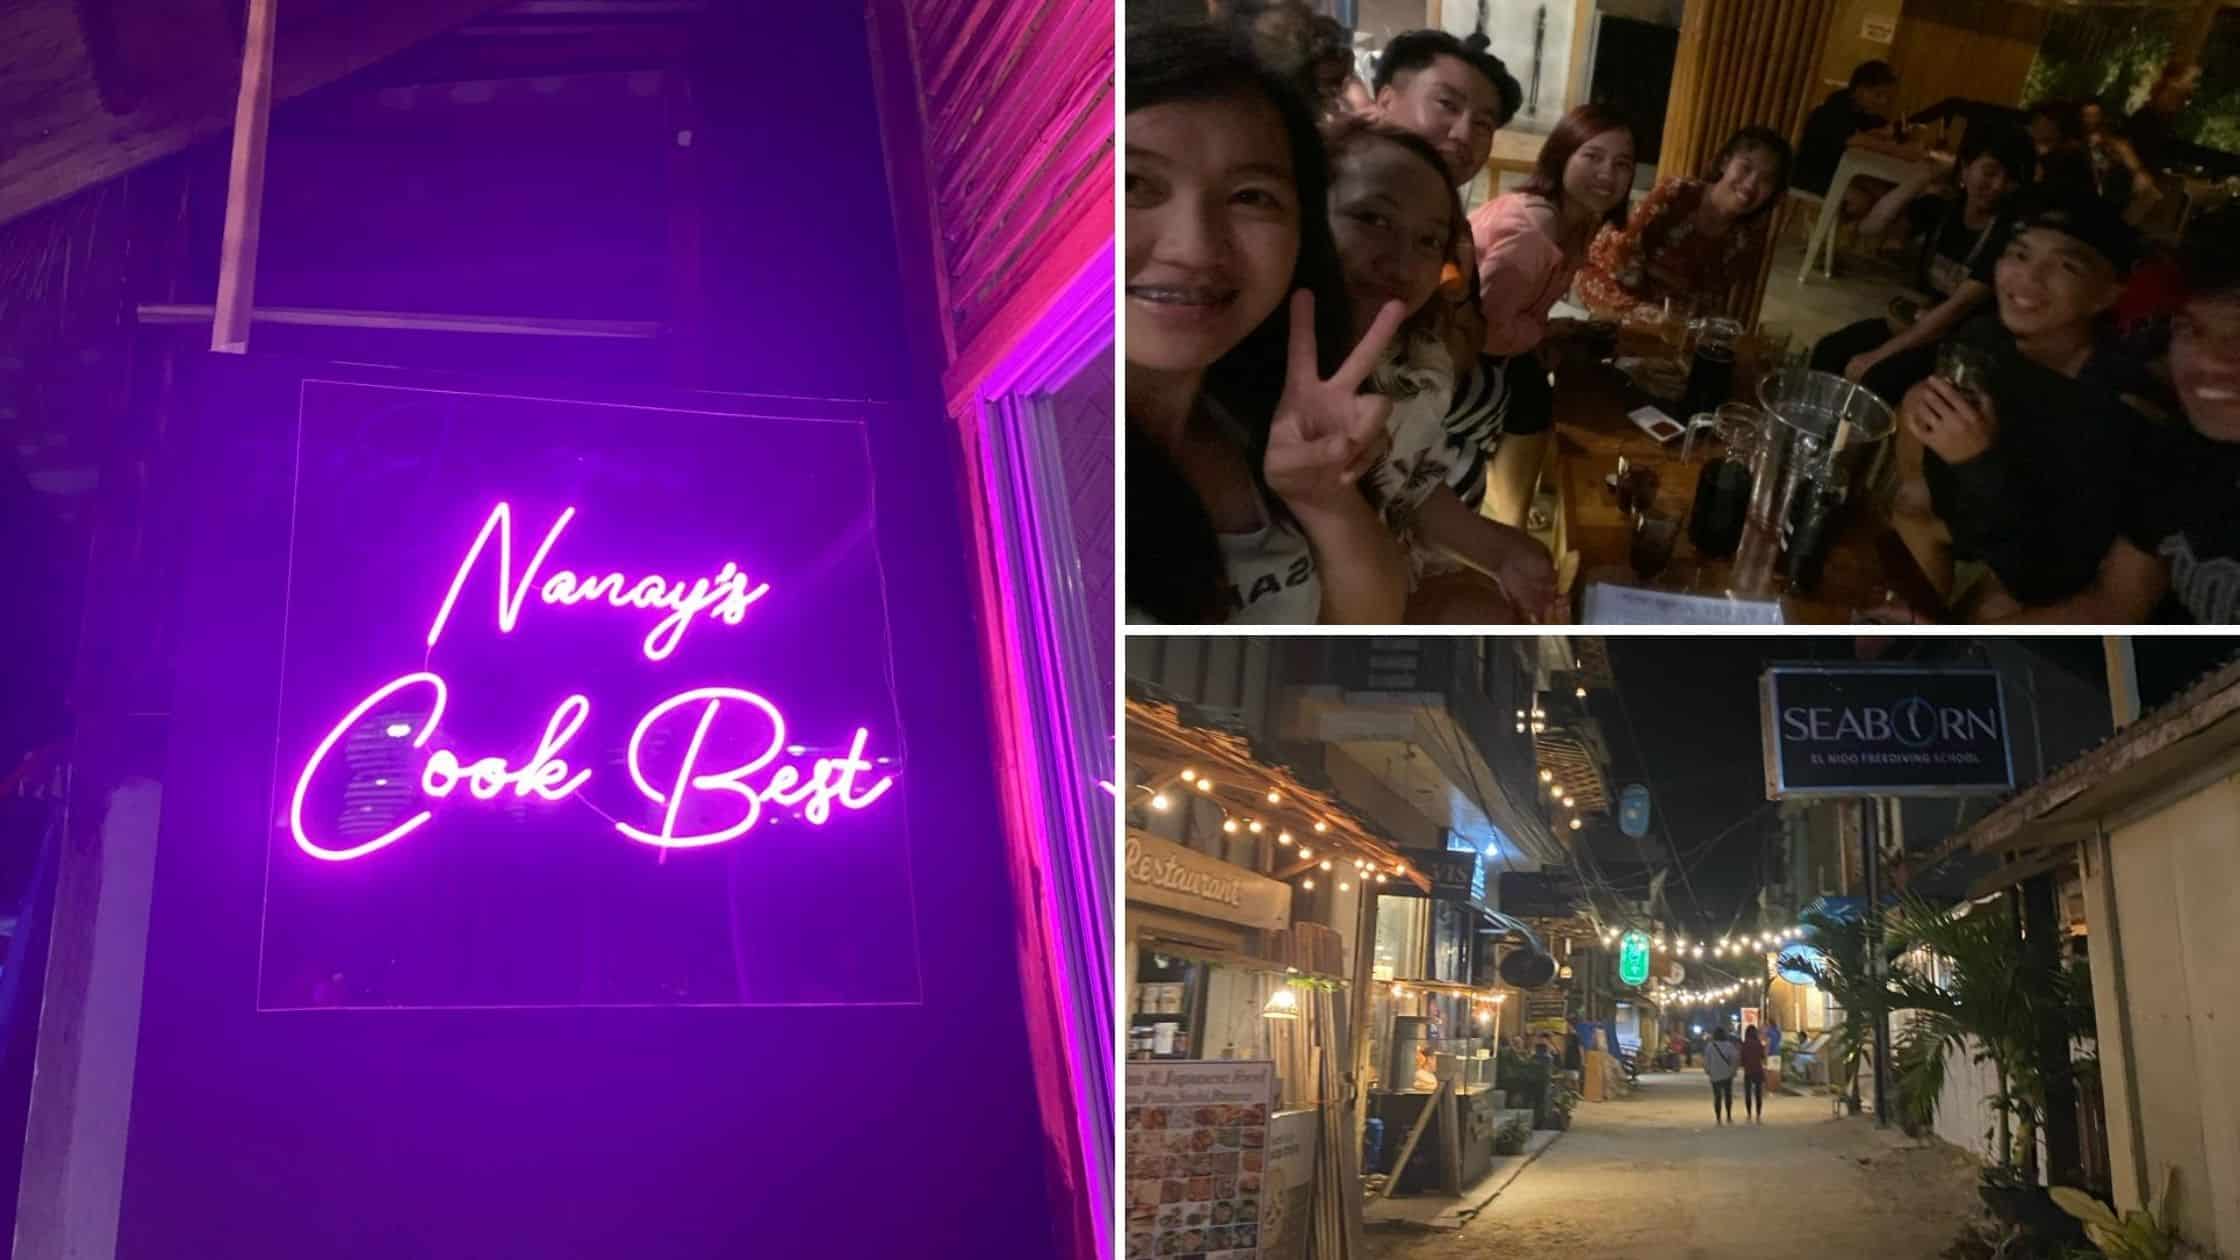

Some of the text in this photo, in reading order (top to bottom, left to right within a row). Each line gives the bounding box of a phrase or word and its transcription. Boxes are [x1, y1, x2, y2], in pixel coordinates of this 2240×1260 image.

[425, 500, 770, 662] Nanay's
[289, 671, 893, 862] Cook Best
[1783, 697, 1999, 746] SEABORN
[1126, 836, 1241, 906] Restaurant
